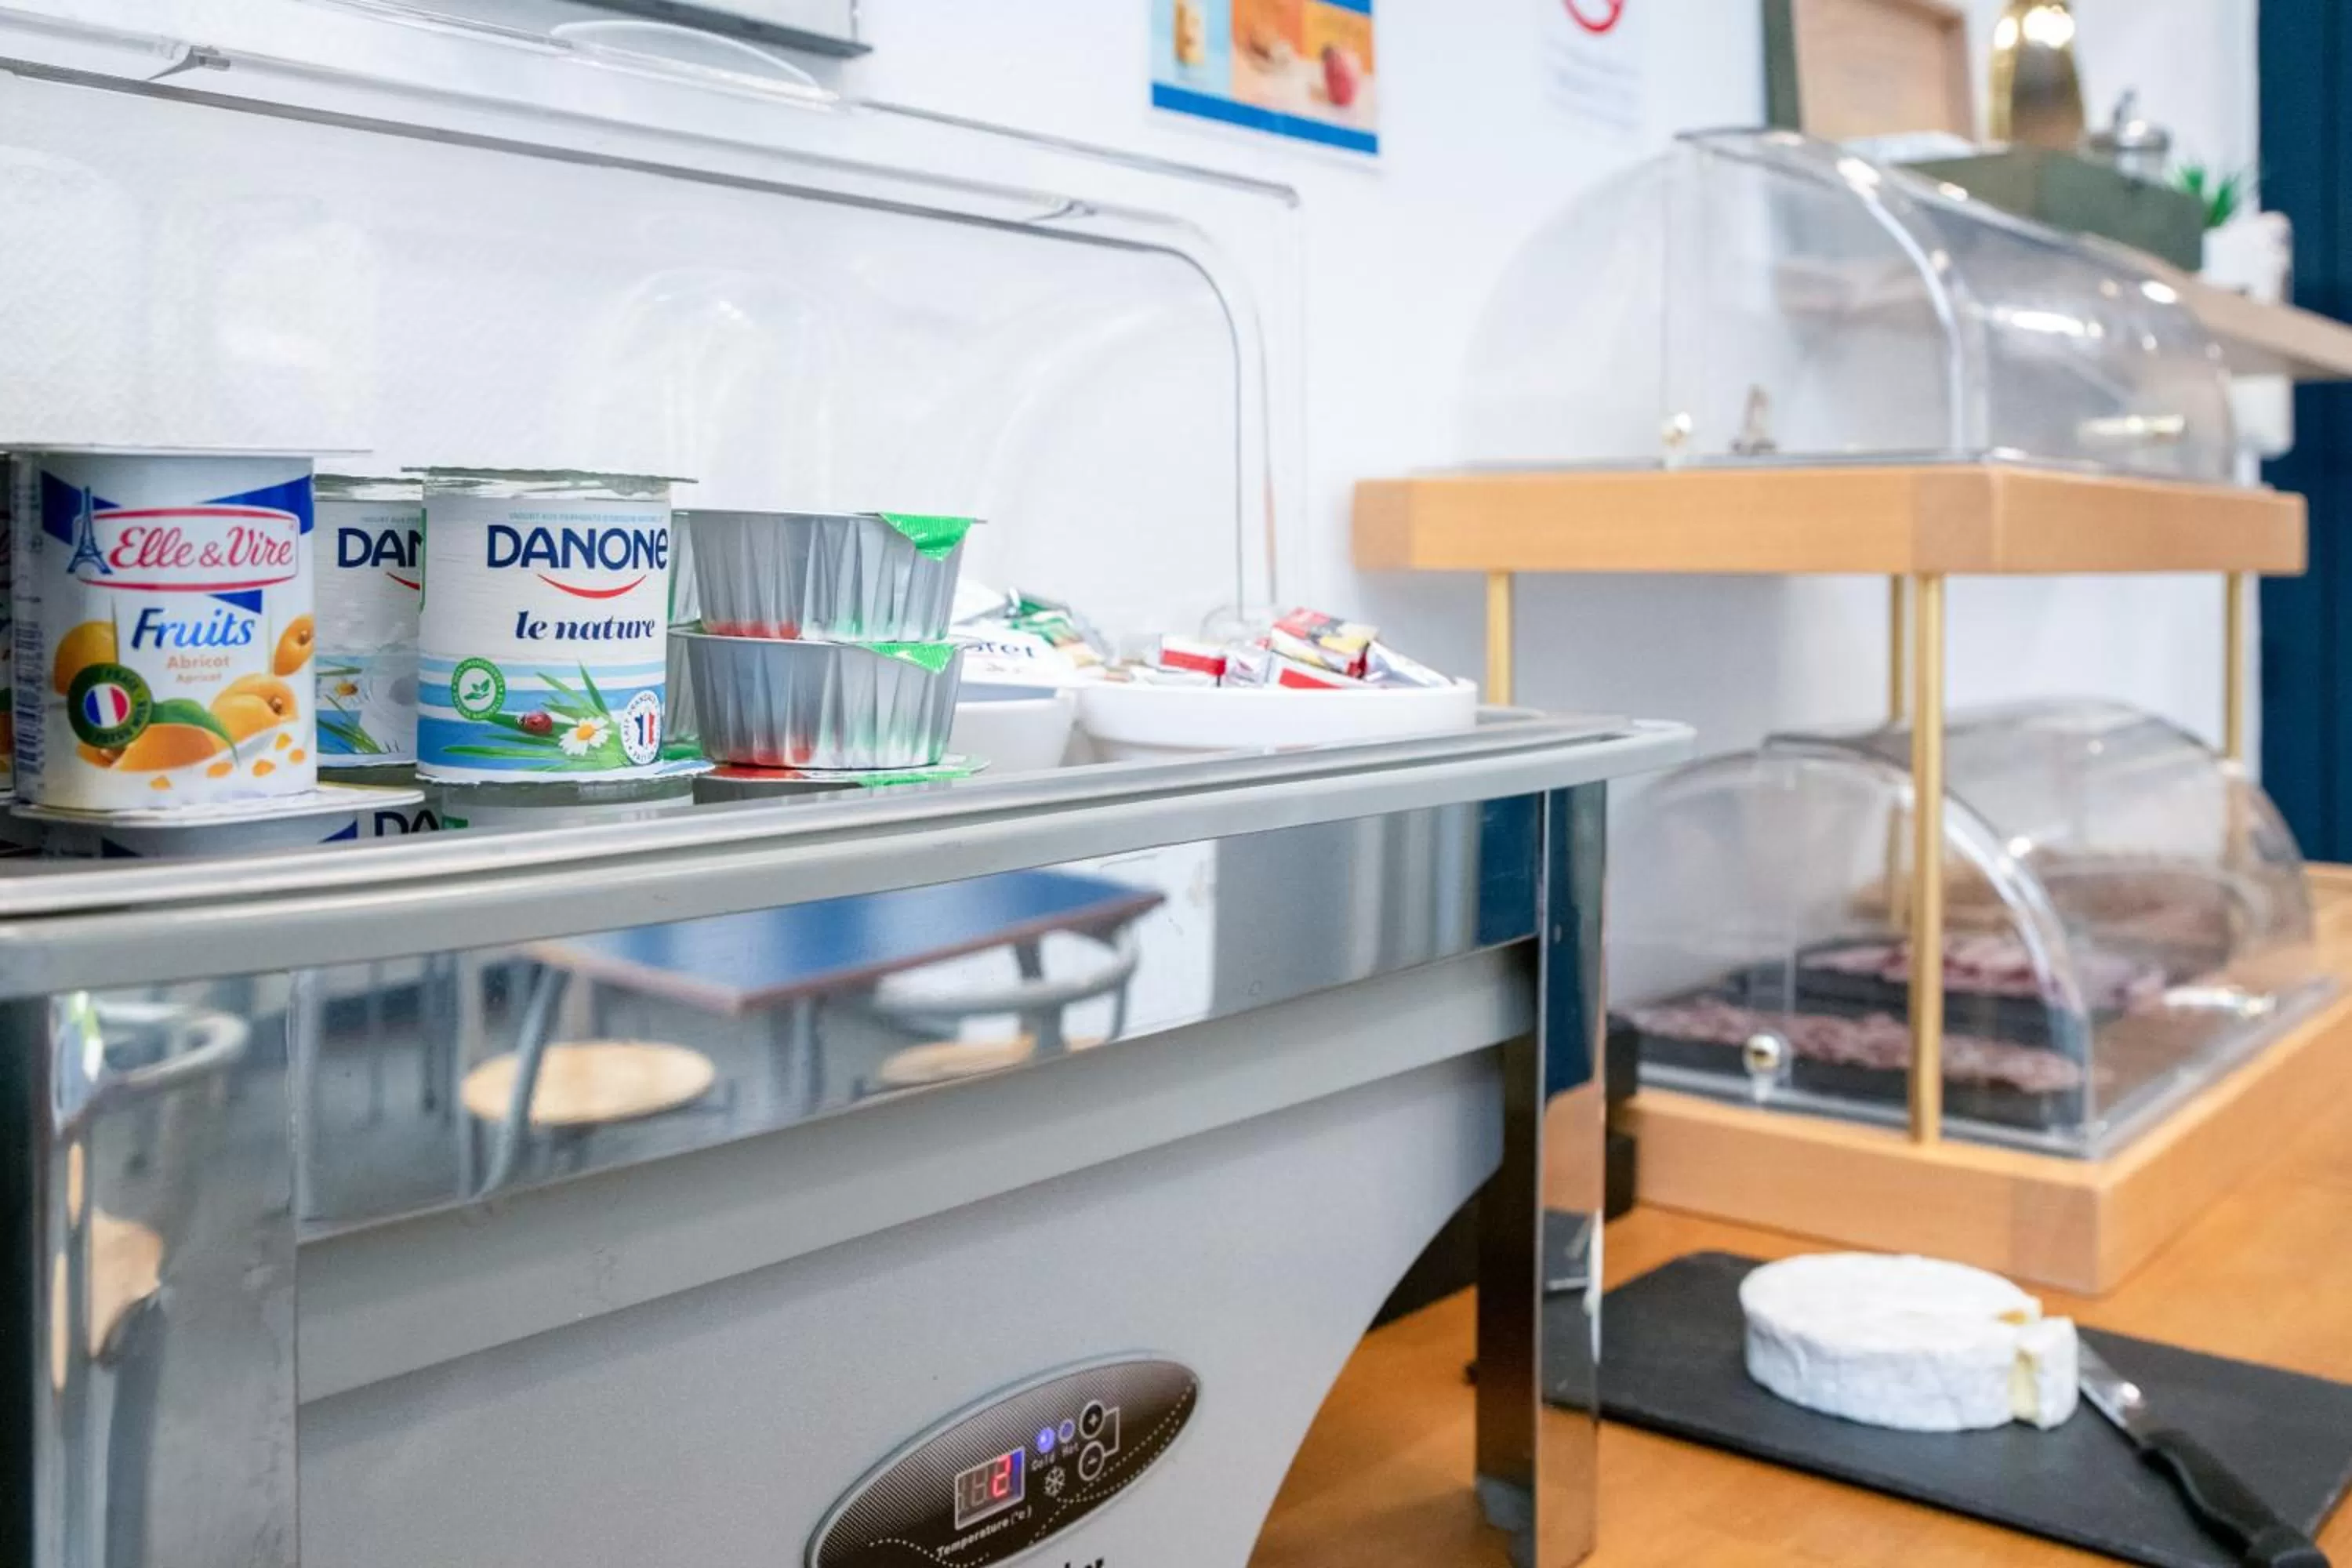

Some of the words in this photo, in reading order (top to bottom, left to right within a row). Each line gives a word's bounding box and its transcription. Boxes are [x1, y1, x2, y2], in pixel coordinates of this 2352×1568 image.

[108, 526, 194, 569] Elle
[199, 543, 225, 568] &
[226, 526, 294, 567] Vire
[131, 608, 256, 650] Fruits
[515, 610, 547, 641] le
[554, 615, 655, 641] nature
[166, 654, 230, 669] Abricot
[936, 1518, 1009, 1558] Temperature
